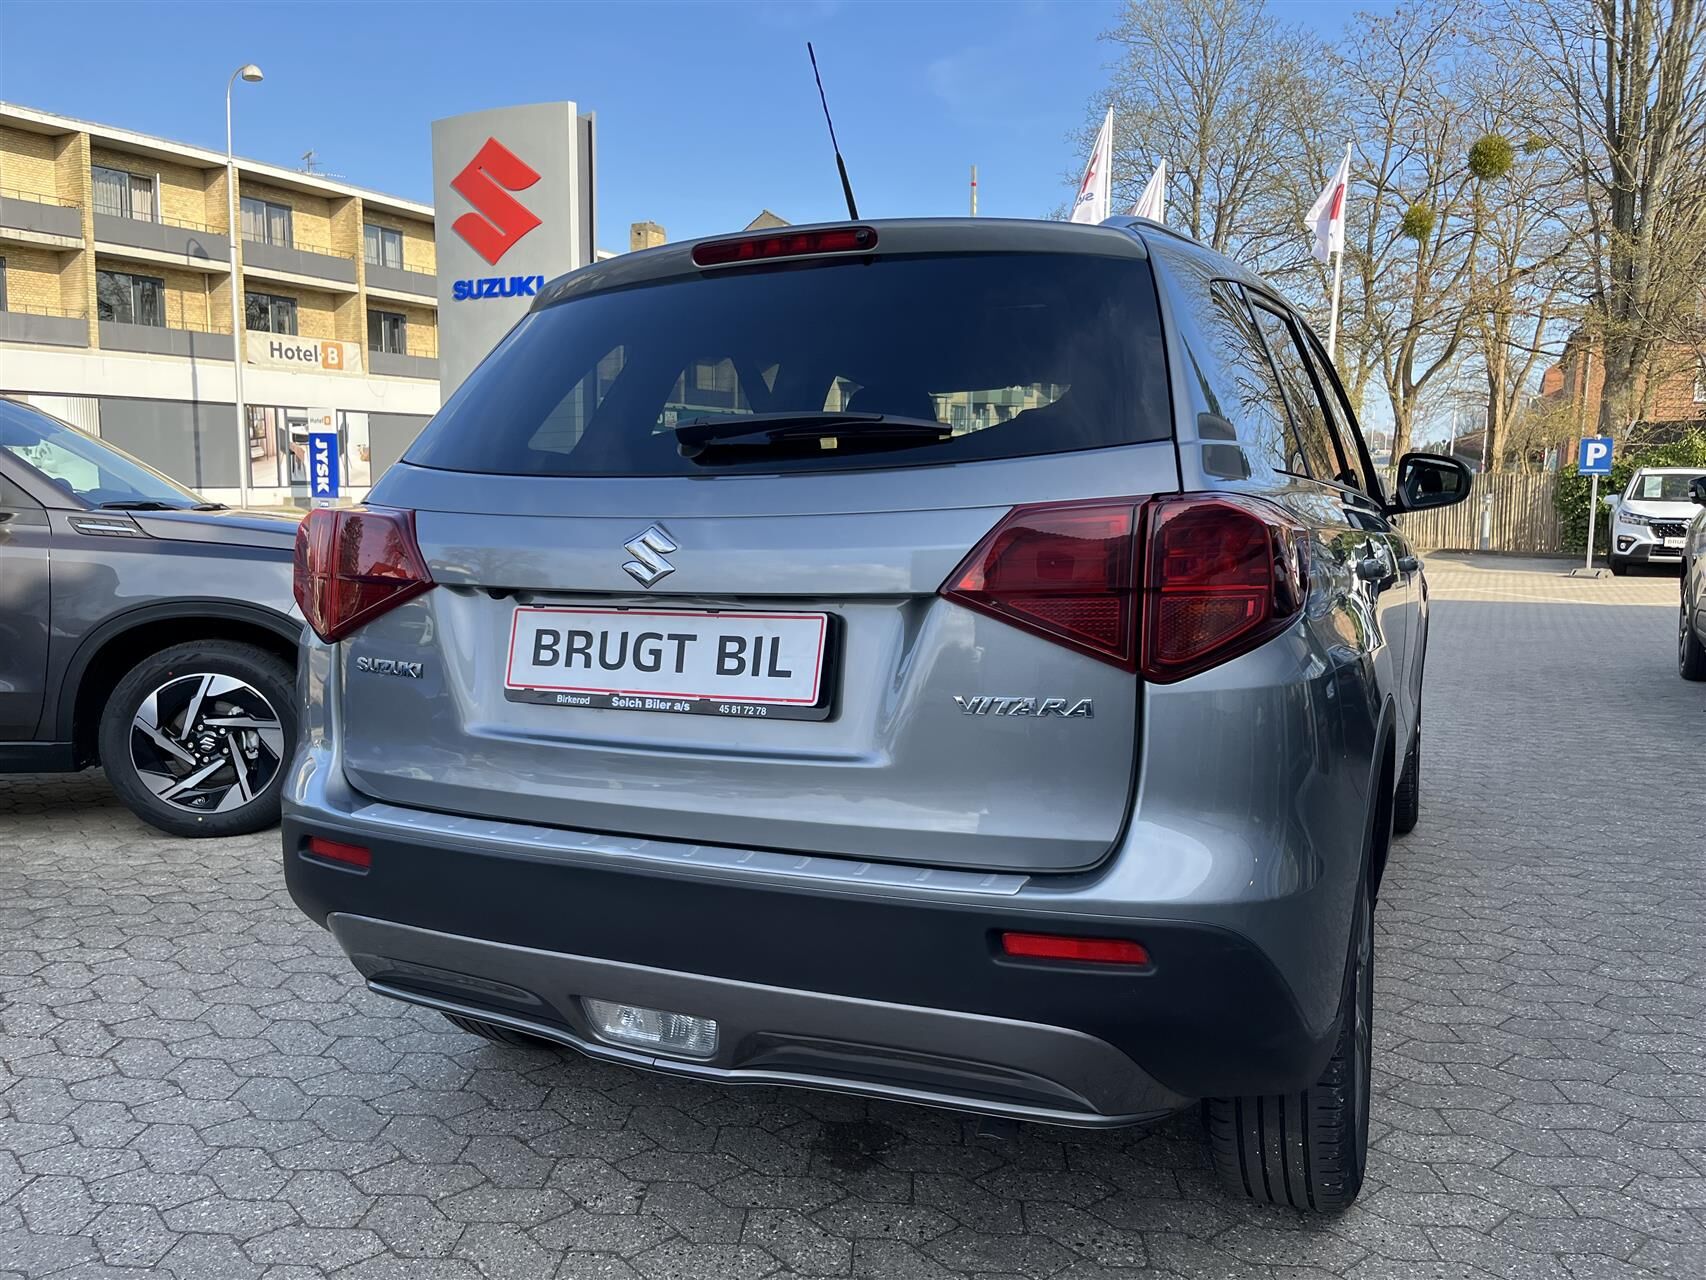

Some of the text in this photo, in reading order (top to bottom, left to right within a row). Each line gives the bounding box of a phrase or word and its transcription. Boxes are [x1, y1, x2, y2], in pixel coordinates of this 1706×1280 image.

[453, 275, 544, 300] SUZUKI
[269, 340, 319, 362] Hotel
[315, 437, 330, 494] JYSK
[1586, 443, 1607, 466] P
[531, 628, 792, 678] BRUGT BIL
[356, 656, 424, 679] SUZUKI
[644, 698, 672, 711] Biler
[673, 700, 691, 712] a/s
[719, 704, 730, 714] 45
[731, 705, 741, 714] 81
[743, 706, 754, 715] 72
[756, 706, 767, 716] 78
[952, 695, 1095, 719] VITARA
